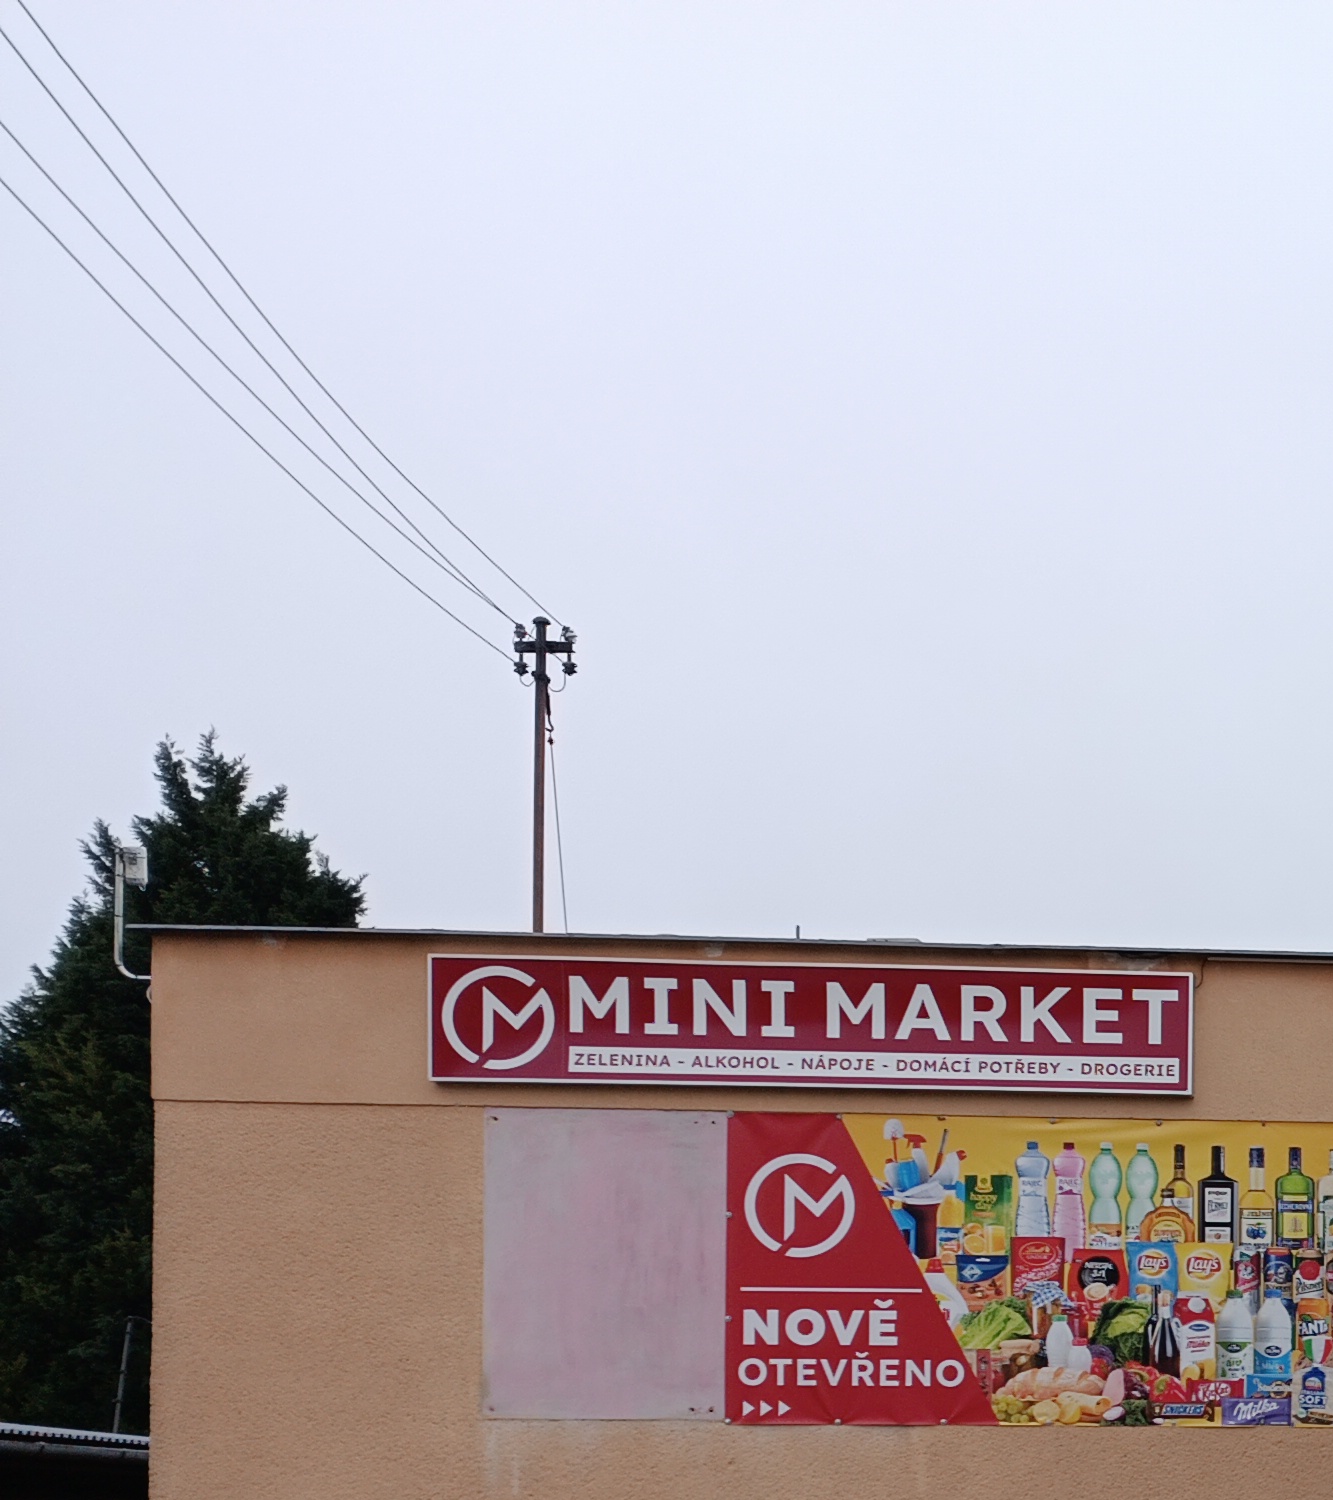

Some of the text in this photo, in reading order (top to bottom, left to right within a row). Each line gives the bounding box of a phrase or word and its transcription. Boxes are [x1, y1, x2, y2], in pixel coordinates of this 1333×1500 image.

[568, 975, 1179, 1046] MINI MARKET
[574, 1053, 671, 1067] ZELENINA
[691, 1055, 780, 1069] ALKOHOL
[801, 1055, 875, 1071] NÁPOJE
[896, 1057, 971, 1073] DOMÁCÍ
[978, 1058, 1060, 1074] POTŘEBY
[1081, 1063, 1176, 1077] DROGERIE
[1189, 1256, 1219, 1273] Lay's
[742, 1299, 898, 1346] NOVĚ
[738, 1352, 965, 1388] OTEVŘENO
[1233, 1399, 1280, 1420] Milka
[1299, 1394, 1328, 1405] SOFT
